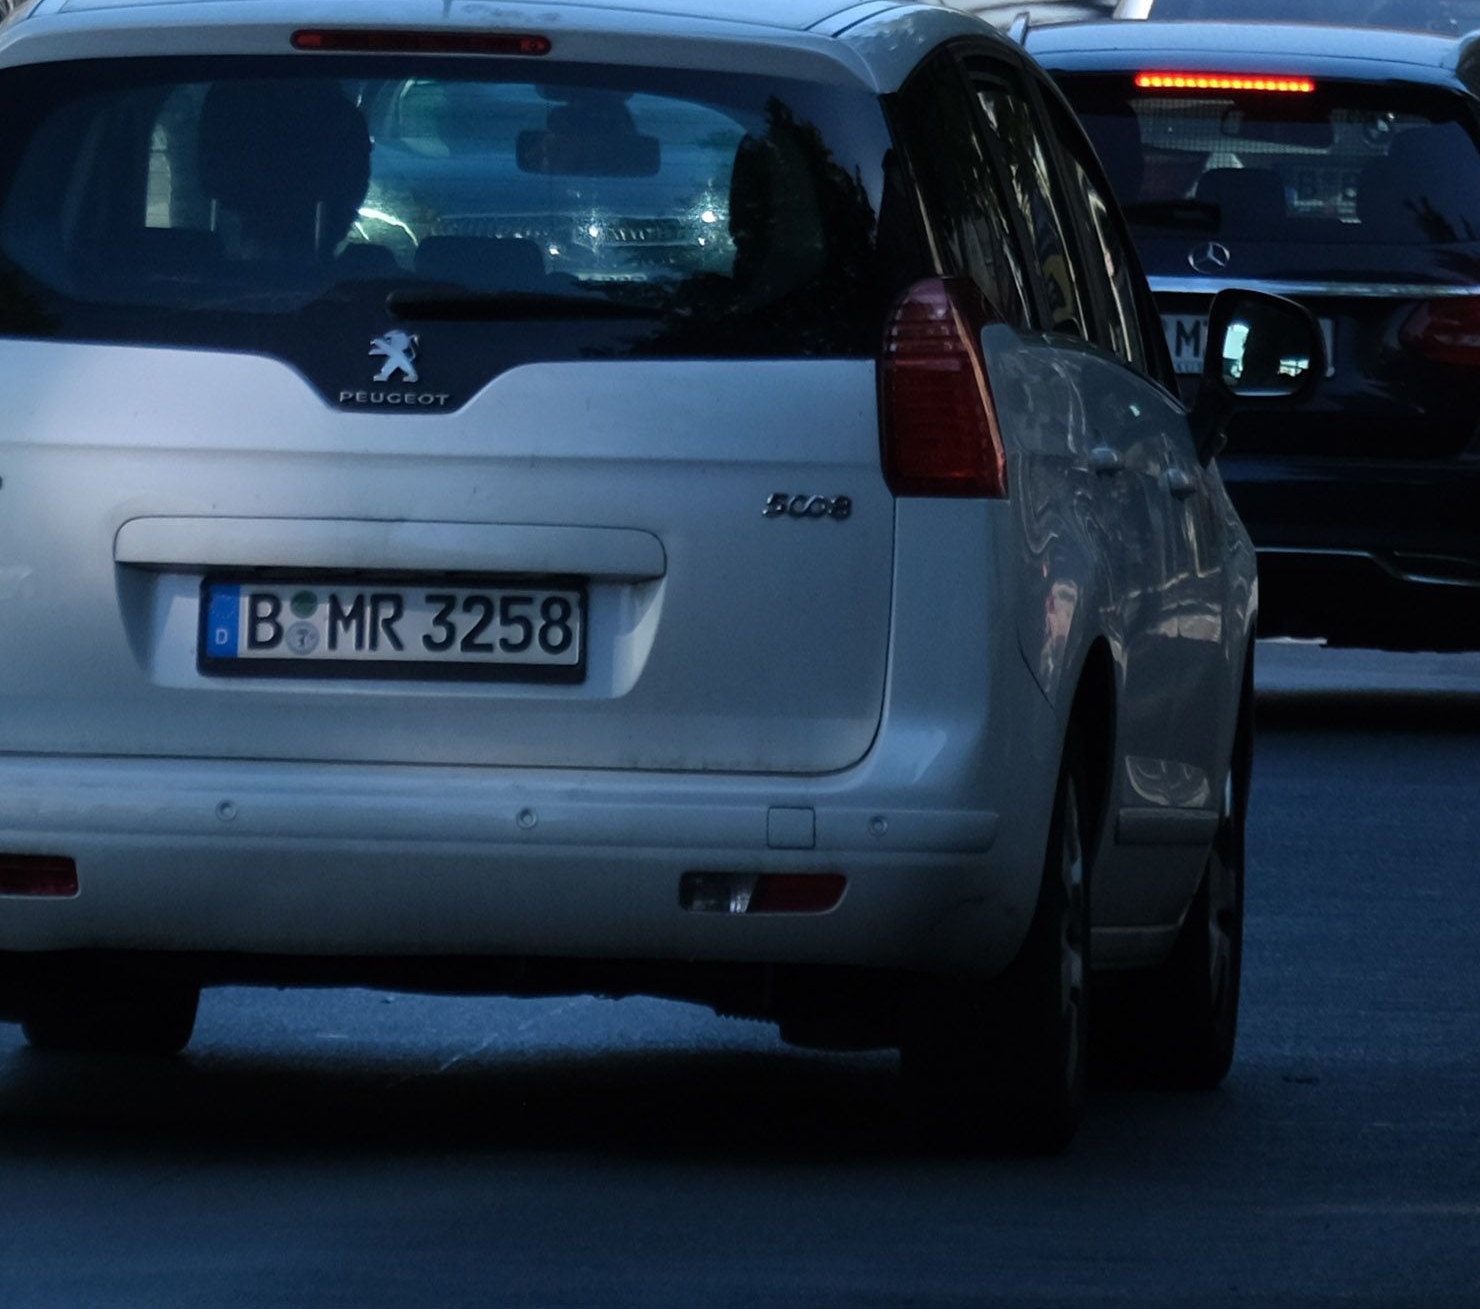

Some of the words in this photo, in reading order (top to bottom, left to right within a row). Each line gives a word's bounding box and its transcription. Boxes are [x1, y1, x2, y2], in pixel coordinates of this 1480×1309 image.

[339, 391, 451, 407] PEUGEOT
[762, 493, 852, 520] 5008
[215, 629, 228, 645] D
[247, 593, 284, 650] B
[328, 593, 405, 651] MR
[423, 594, 573, 655] 3258
